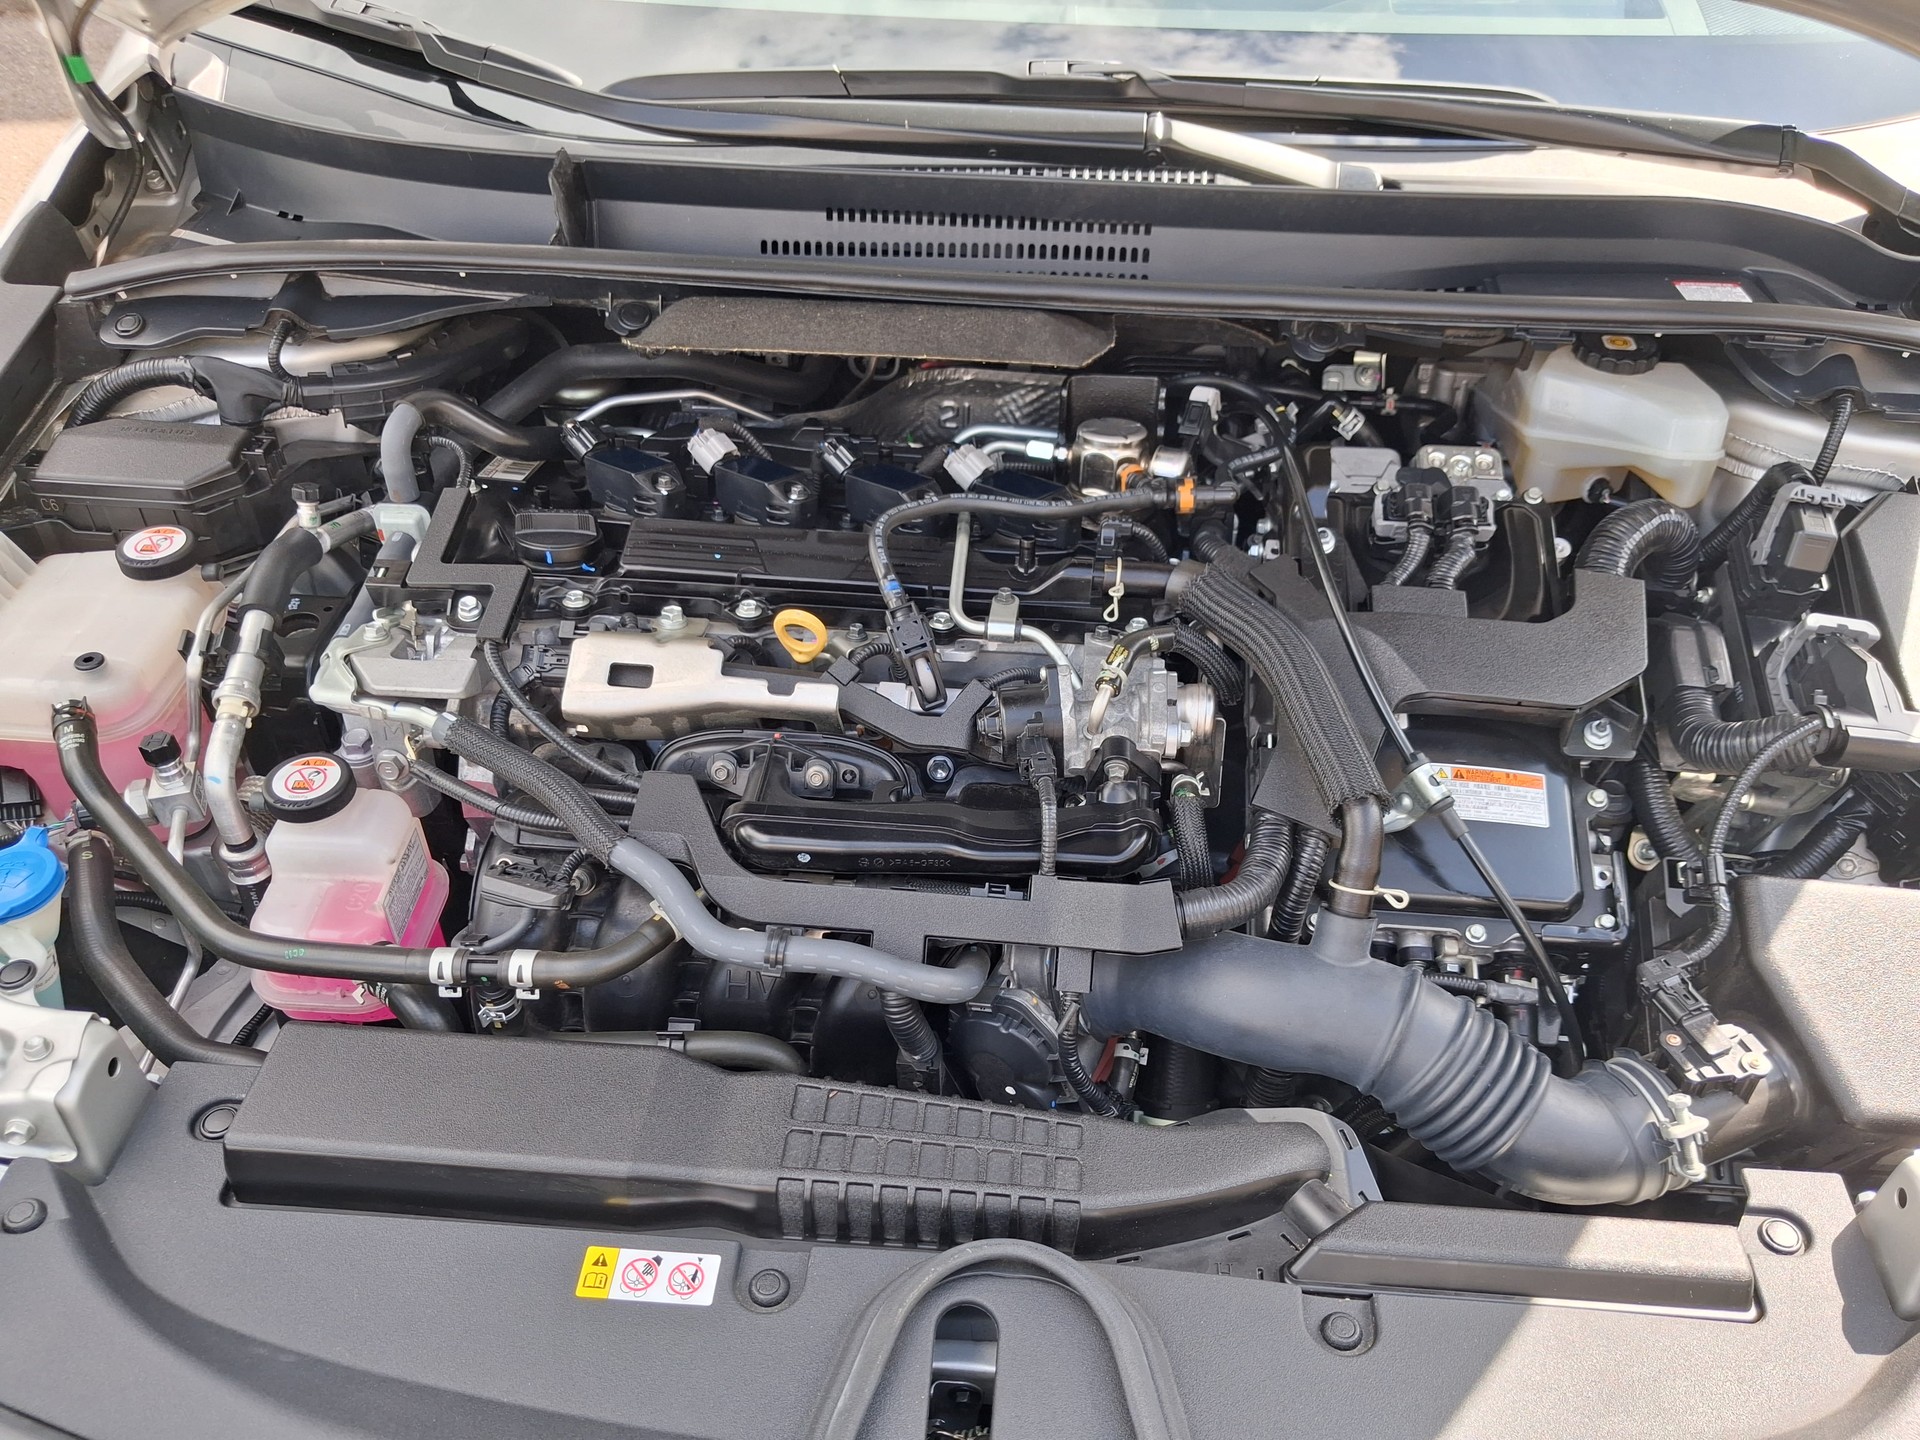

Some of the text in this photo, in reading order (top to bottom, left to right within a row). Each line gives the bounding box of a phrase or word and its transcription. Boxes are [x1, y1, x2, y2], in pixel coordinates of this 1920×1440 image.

[40, 498, 60, 512] C6
[63, 724, 74, 733] M
[81, 850, 93, 860] S
[725, 969, 778, 1001] HV
